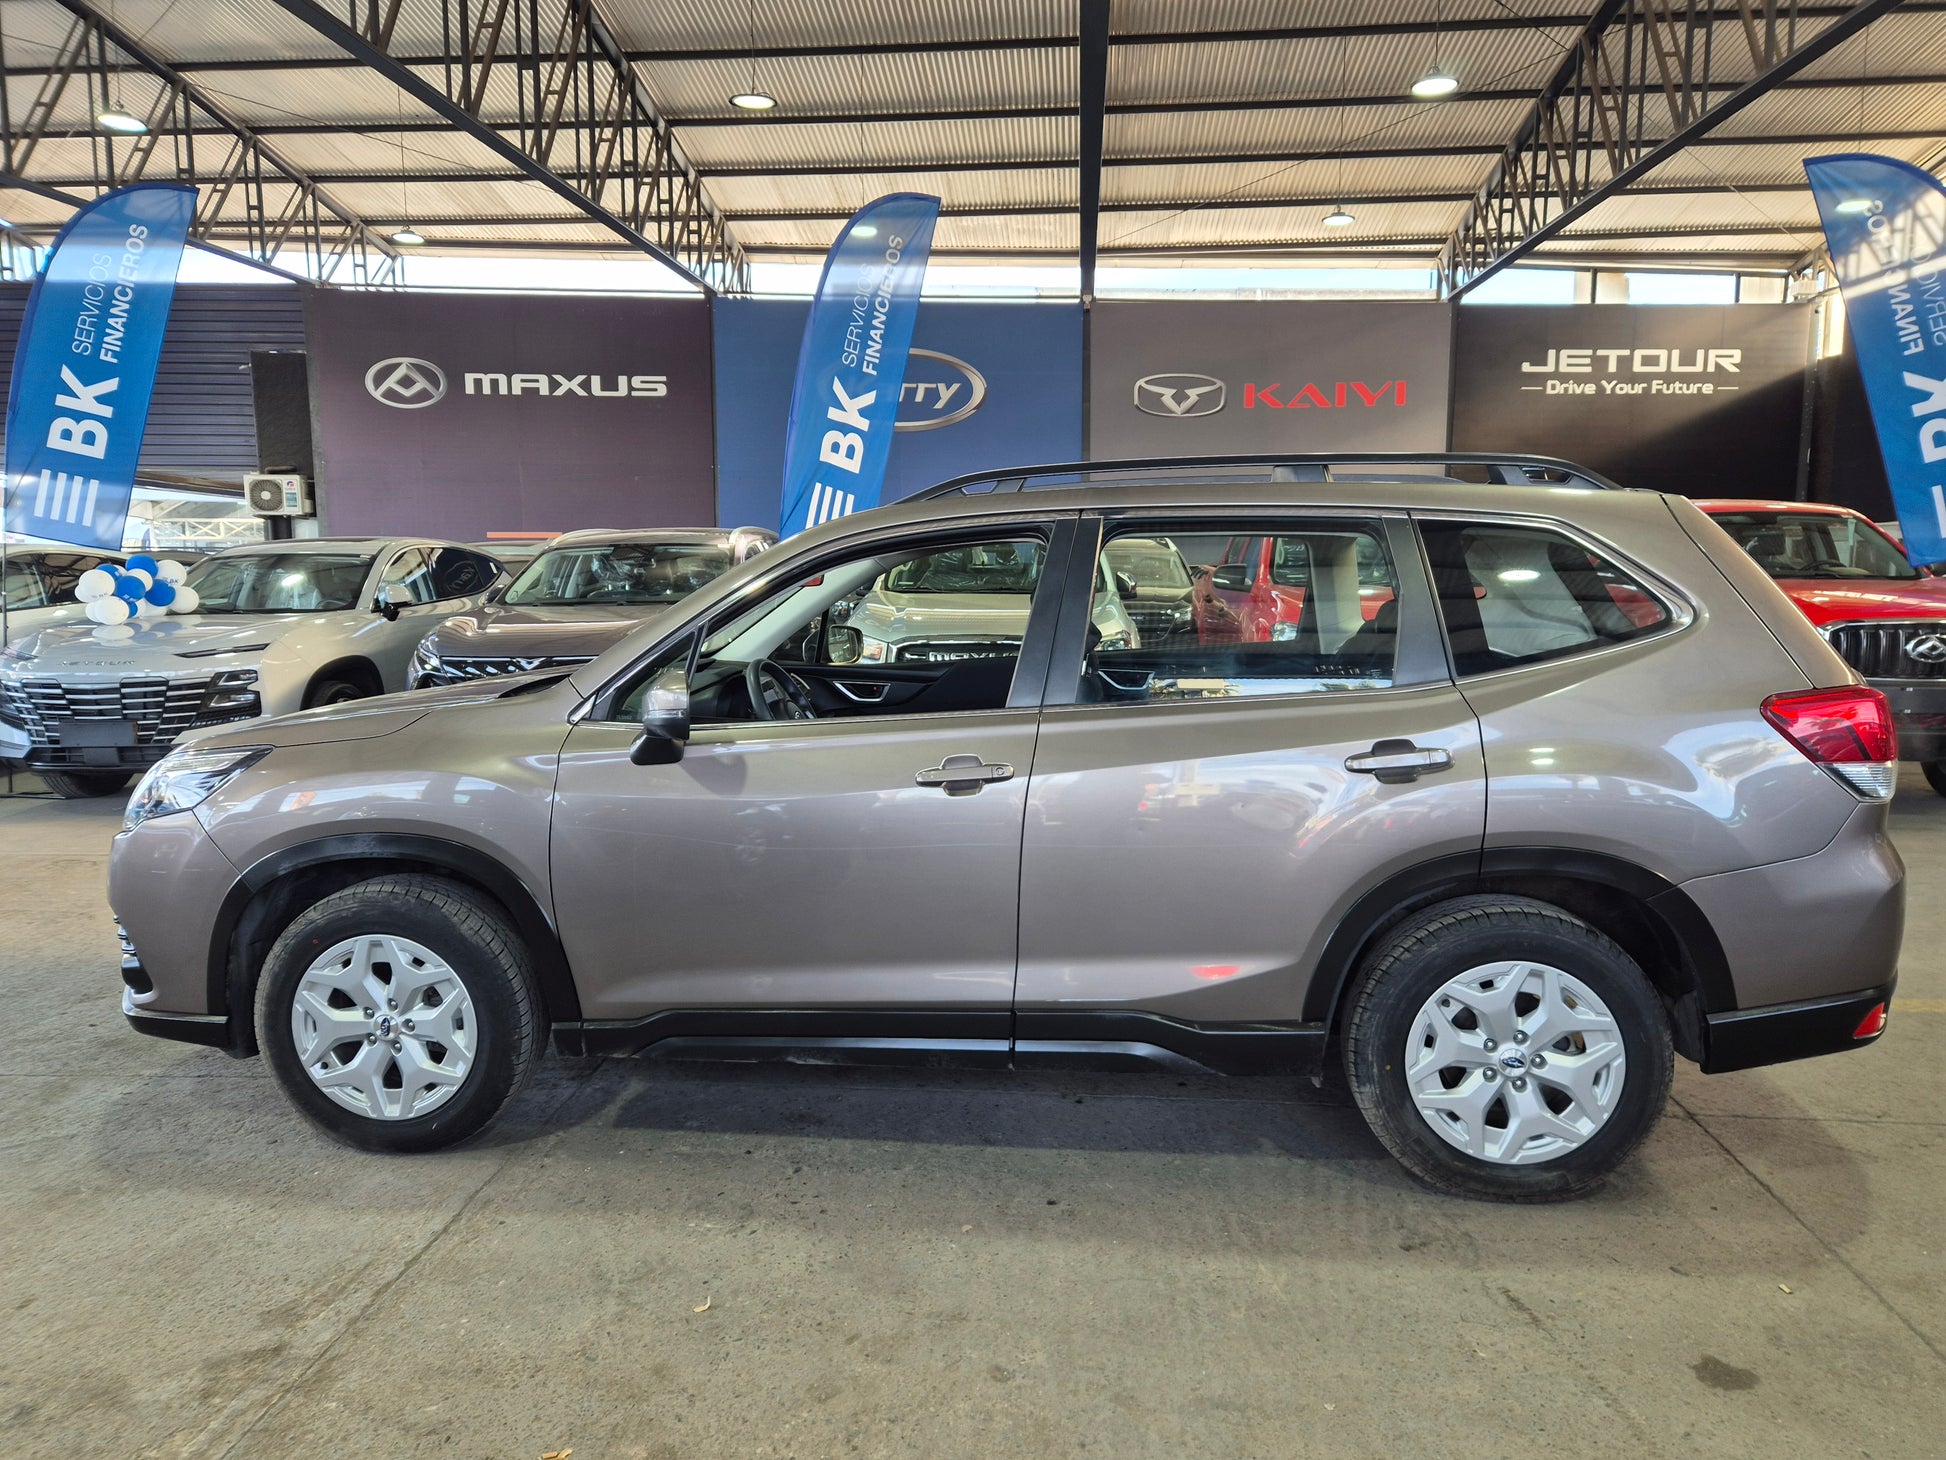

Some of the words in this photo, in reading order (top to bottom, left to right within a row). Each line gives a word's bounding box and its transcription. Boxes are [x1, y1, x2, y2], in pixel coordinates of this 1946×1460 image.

[72, 253, 112, 356] SERVICIOS
[100, 223, 148, 364] FINANCIEROS
[842, 262, 876, 368] SERVICIOS
[862, 235, 903, 376] FINANCIEROS
[464, 372, 668, 397] MAXUS
[1243, 380, 1407, 409] KAIYI
[1521, 348, 1742, 373] JETOUR
[1546, 379, 1597, 395] Drive
[1600, 379, 1648, 395] Your
[1651, 379, 1714, 395] Future
[46, 363, 120, 461] BK
[820, 375, 878, 475] BK
